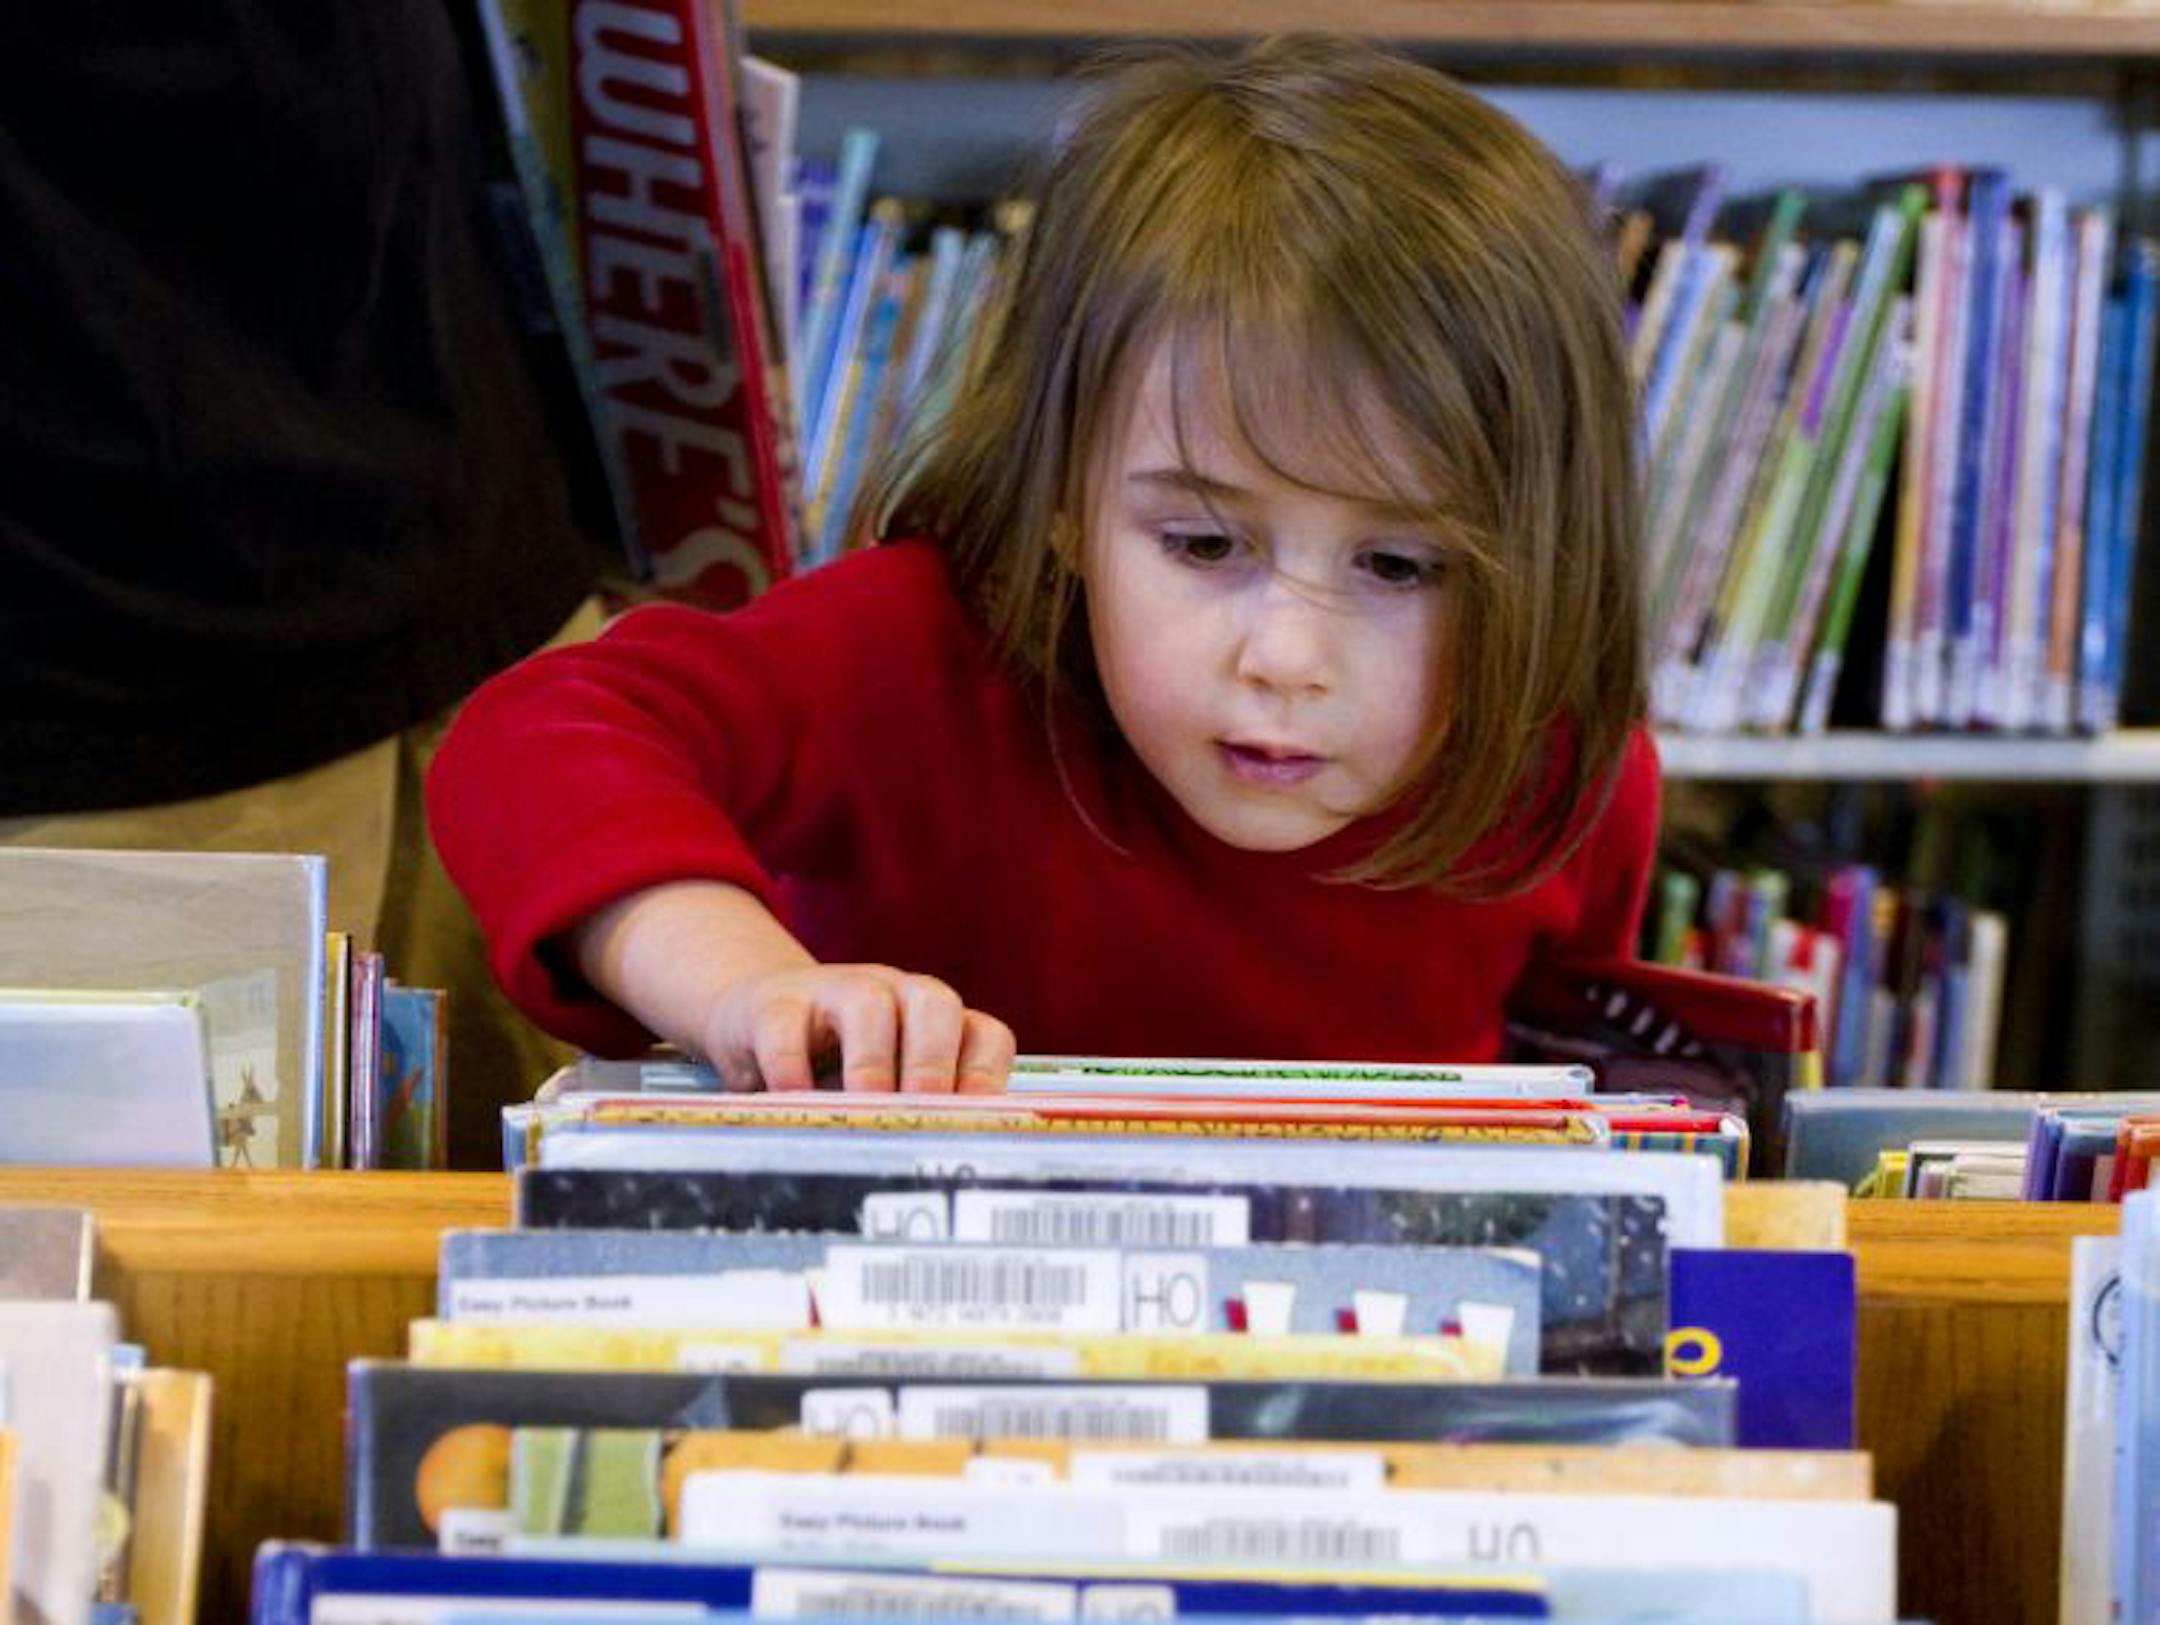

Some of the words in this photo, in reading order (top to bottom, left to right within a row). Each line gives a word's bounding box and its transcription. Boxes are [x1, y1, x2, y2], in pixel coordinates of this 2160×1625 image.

[573, 1, 769, 604] WHERE'S
[1132, 1271, 1199, 1328] HO
[836, 1512, 907, 1531] Picture
[915, 1513, 966, 1532] Book
